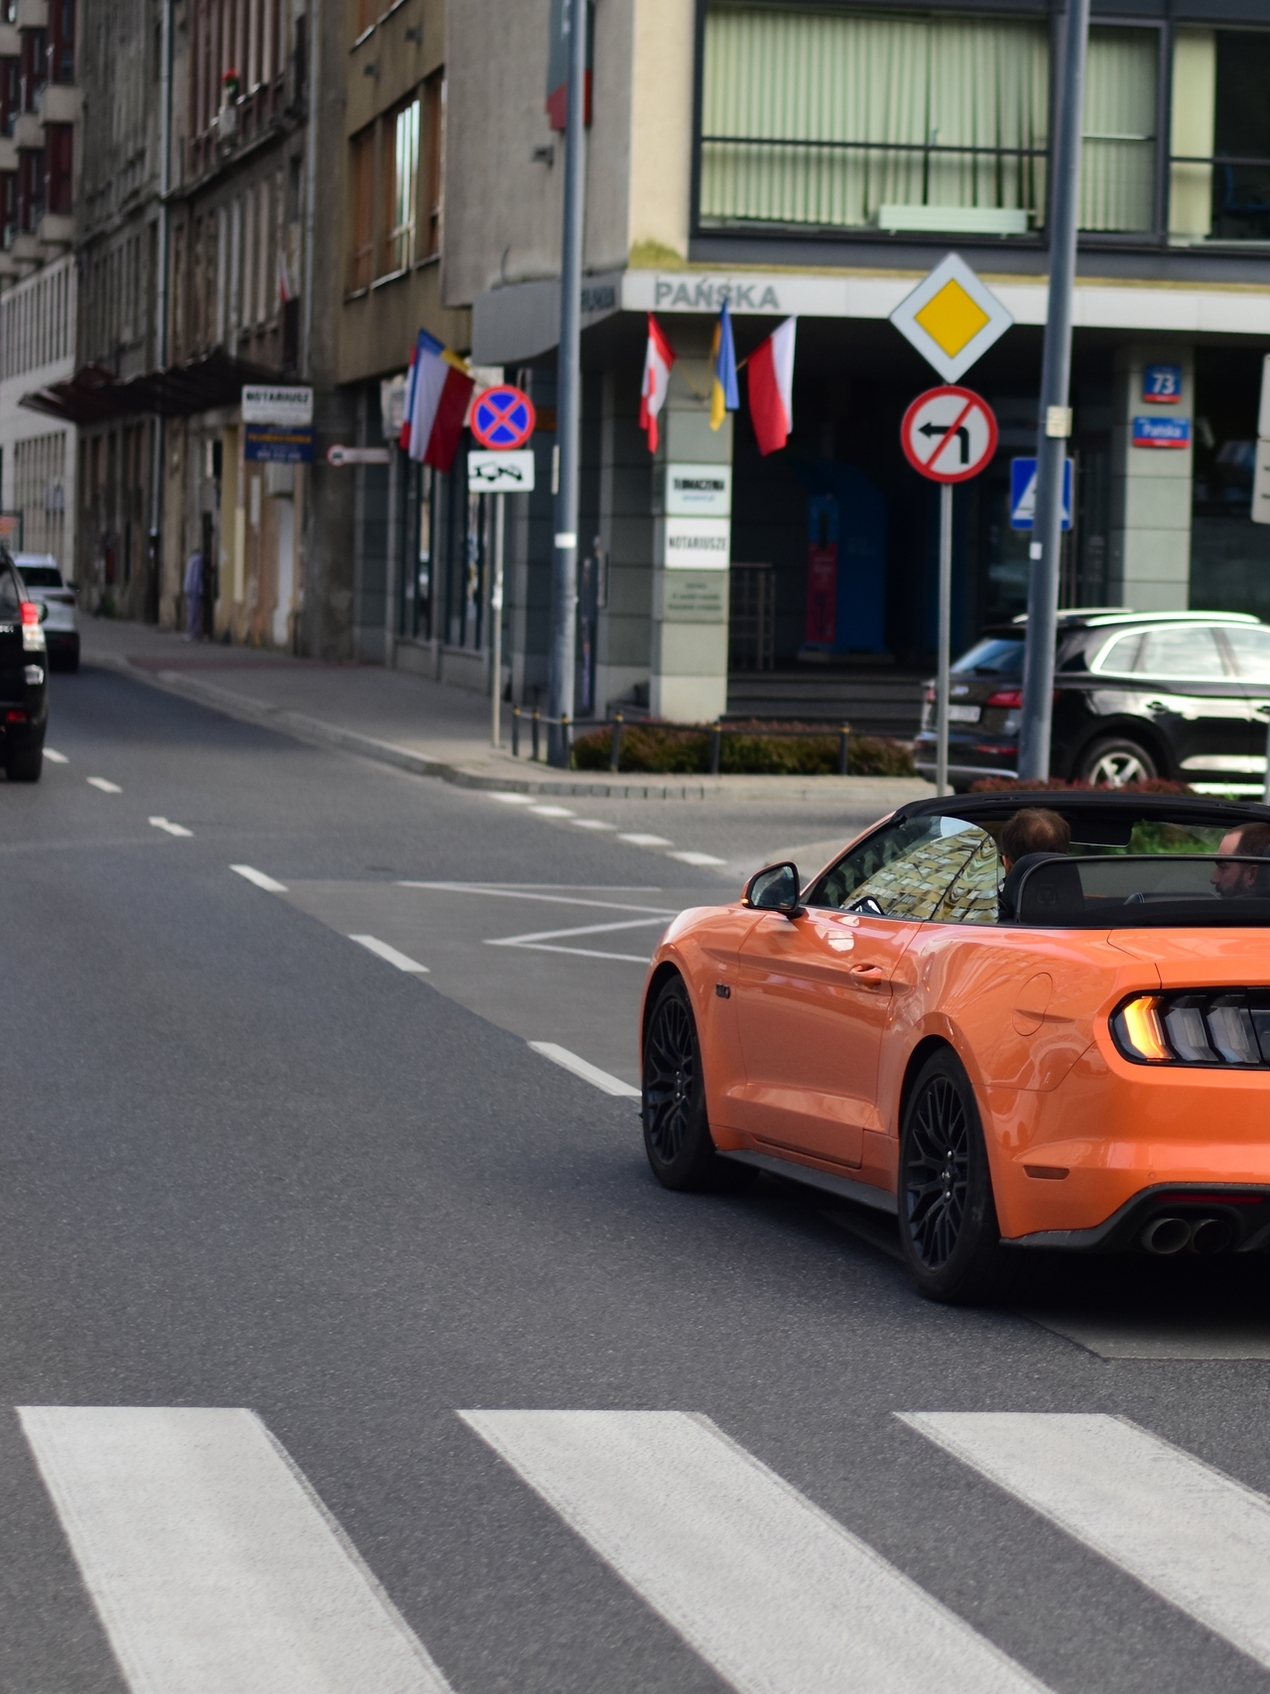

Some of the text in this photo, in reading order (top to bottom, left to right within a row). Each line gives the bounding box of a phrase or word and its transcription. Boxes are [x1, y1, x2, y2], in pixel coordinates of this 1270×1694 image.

[655, 278, 780, 309] PAŃSKA
[1152, 373, 1175, 394] 73
[669, 536, 726, 550] NOTARIUSZE
